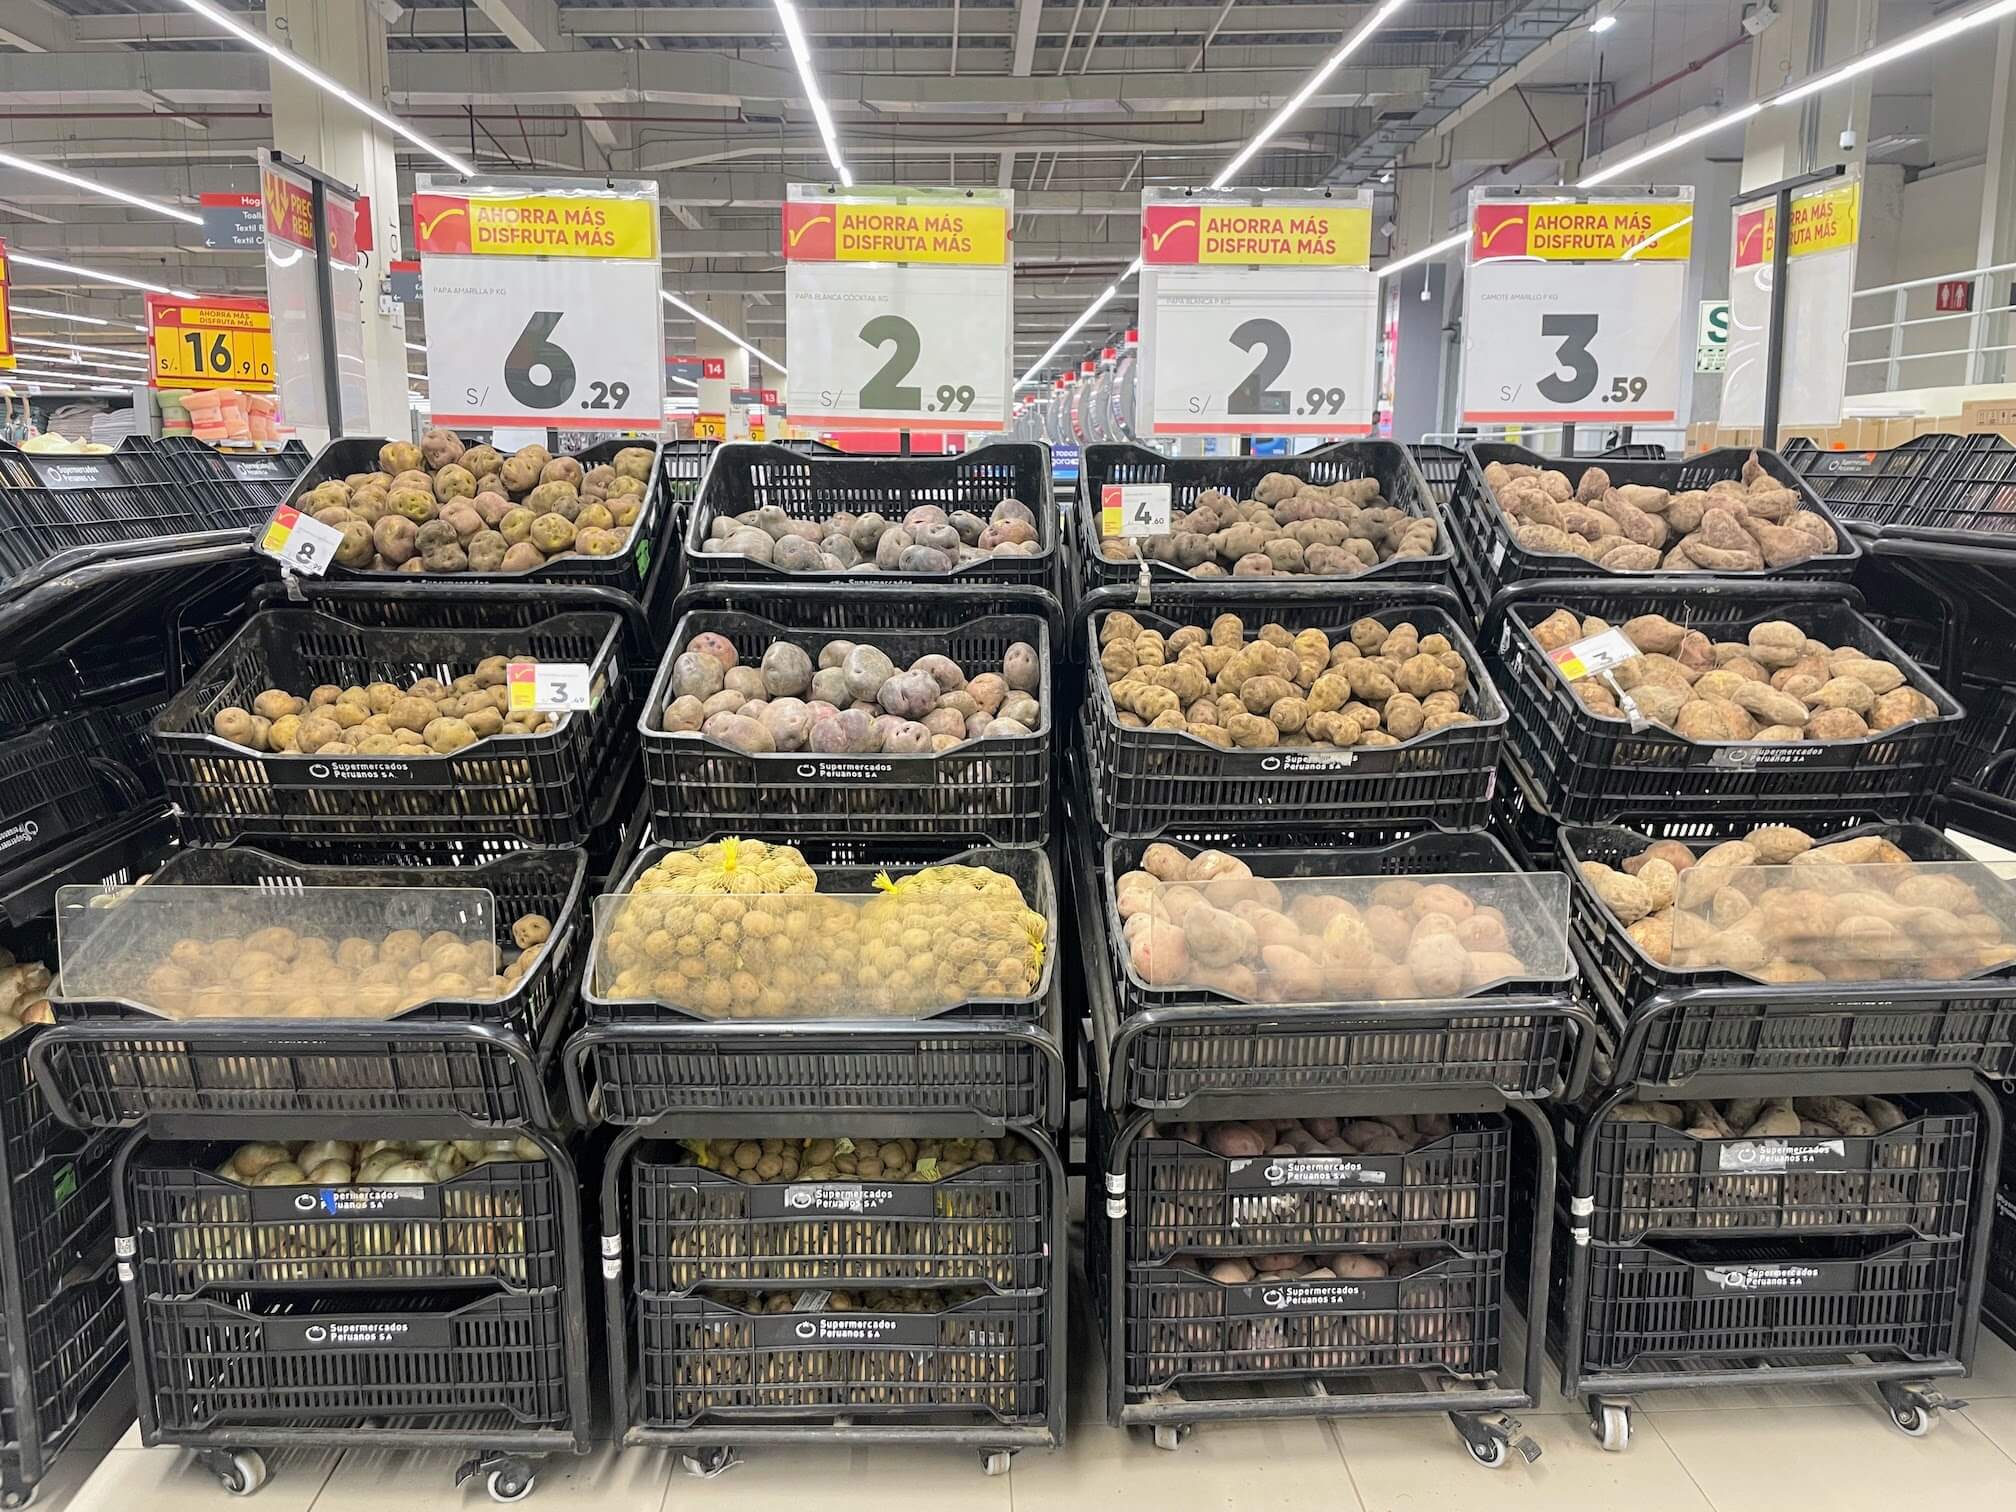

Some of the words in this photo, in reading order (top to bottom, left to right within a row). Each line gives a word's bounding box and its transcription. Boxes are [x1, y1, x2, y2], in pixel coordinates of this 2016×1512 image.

[477, 207, 559, 225] AHORRA
[565, 206, 606, 226] MÁS
[1811, 201, 1834, 221] MÁS
[842, 215, 920, 231] AHORRA
[925, 213, 964, 233] MÁS
[1206, 217, 1284, 234] AHORRA
[1290, 216, 1329, 235] MÁS
[1534, 215, 1609, 231] AHORRA
[1614, 212, 1652, 231] MÁS
[235, 223, 257, 232] Textil
[1814, 220, 1838, 241] MÁS
[232, 236, 254, 244] Textil
[478, 227, 569, 246] DISFRUTA
[574, 227, 616, 247] MÁS
[1533, 234, 1616, 249] DISFRUTA
[1621, 232, 1659, 250] MÁS
[842, 234, 928, 252] DISFRUTA
[933, 234, 972, 252] MÁS
[1206, 237, 1291, 254] DISFRUTA
[1298, 236, 1337, 255] MÁS
[199, 310, 232, 319] AHORRA
[232, 310, 251, 319] MÁS
[199, 317, 237, 326] DISFRUTA
[237, 318, 254, 327] MÁS
[184, 332, 232, 373] 16
[466, 386, 489, 407] S/
[504, 311, 577, 410] 6
[580, 381, 631, 410] .29
[820, 390, 843, 409] S/
[858, 314, 922, 411] 2
[927, 384, 976, 412] .99
[1500, 384, 1522, 403] S/
[1535, 313, 1600, 405] 3
[1601, 376, 1648, 404] .59
[707, 363, 722, 375] 14
[1188, 394, 1212, 416] S/
[1228, 318, 1292, 415] 2
[1296, 387, 1346, 416] .99
[765, 394, 775, 402] 13
[702, 424, 715, 437] 19
[1134, 502, 1152, 525] 4
[295, 542, 316, 565] 8
[550, 682, 569, 703] 3
[331, 762, 408, 771] Supermercados
[819, 762, 892, 772] Supermercados
[334, 770, 379, 779] Peruanos
[819, 770, 863, 778] Peruanos
[1287, 1162, 1362, 1172] Supermercados
[1287, 1171, 1331, 1180] Peruanos
[321, 1190, 399, 1201] permercados
[815, 1189, 893, 1199] Supermercados
[320, 1200, 368, 1209] Pruanos
[816, 1199, 861, 1208] Peruanos
[1746, 1267, 1819, 1277] Supermercados
[1746, 1277, 1788, 1285] Peruanos
[1286, 1285, 1359, 1296] Supermercados
[1286, 1295, 1329, 1304] Peruanos
[329, 1322, 409, 1333] Supermercados
[819, 1319, 897, 1329] Supermercados
[330, 1332, 377, 1342] Peruanos
[820, 1329, 865, 1338] Peruanos
